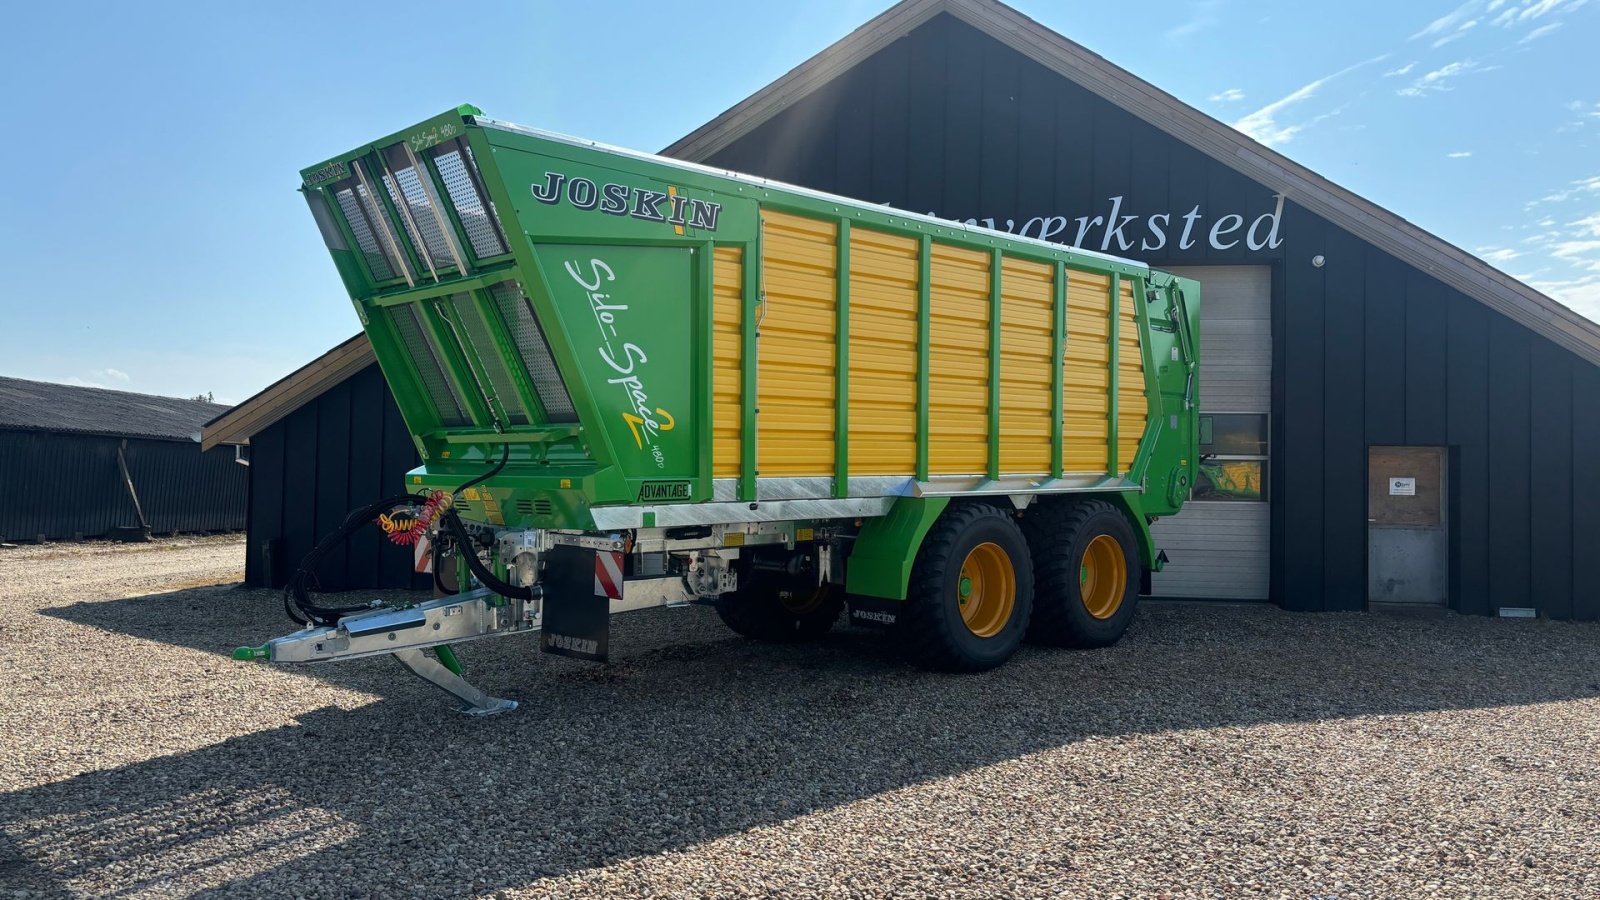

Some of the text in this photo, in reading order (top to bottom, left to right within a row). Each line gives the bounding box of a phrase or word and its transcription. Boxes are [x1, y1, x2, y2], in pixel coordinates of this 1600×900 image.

[305, 161, 346, 186] JOSKIN
[531, 171, 722, 232] JOSKIN
[637, 484, 688, 502] ADVANTAGE
[852, 609, 897, 624] JOSKIN
[548, 633, 598, 655] JOSKIN
